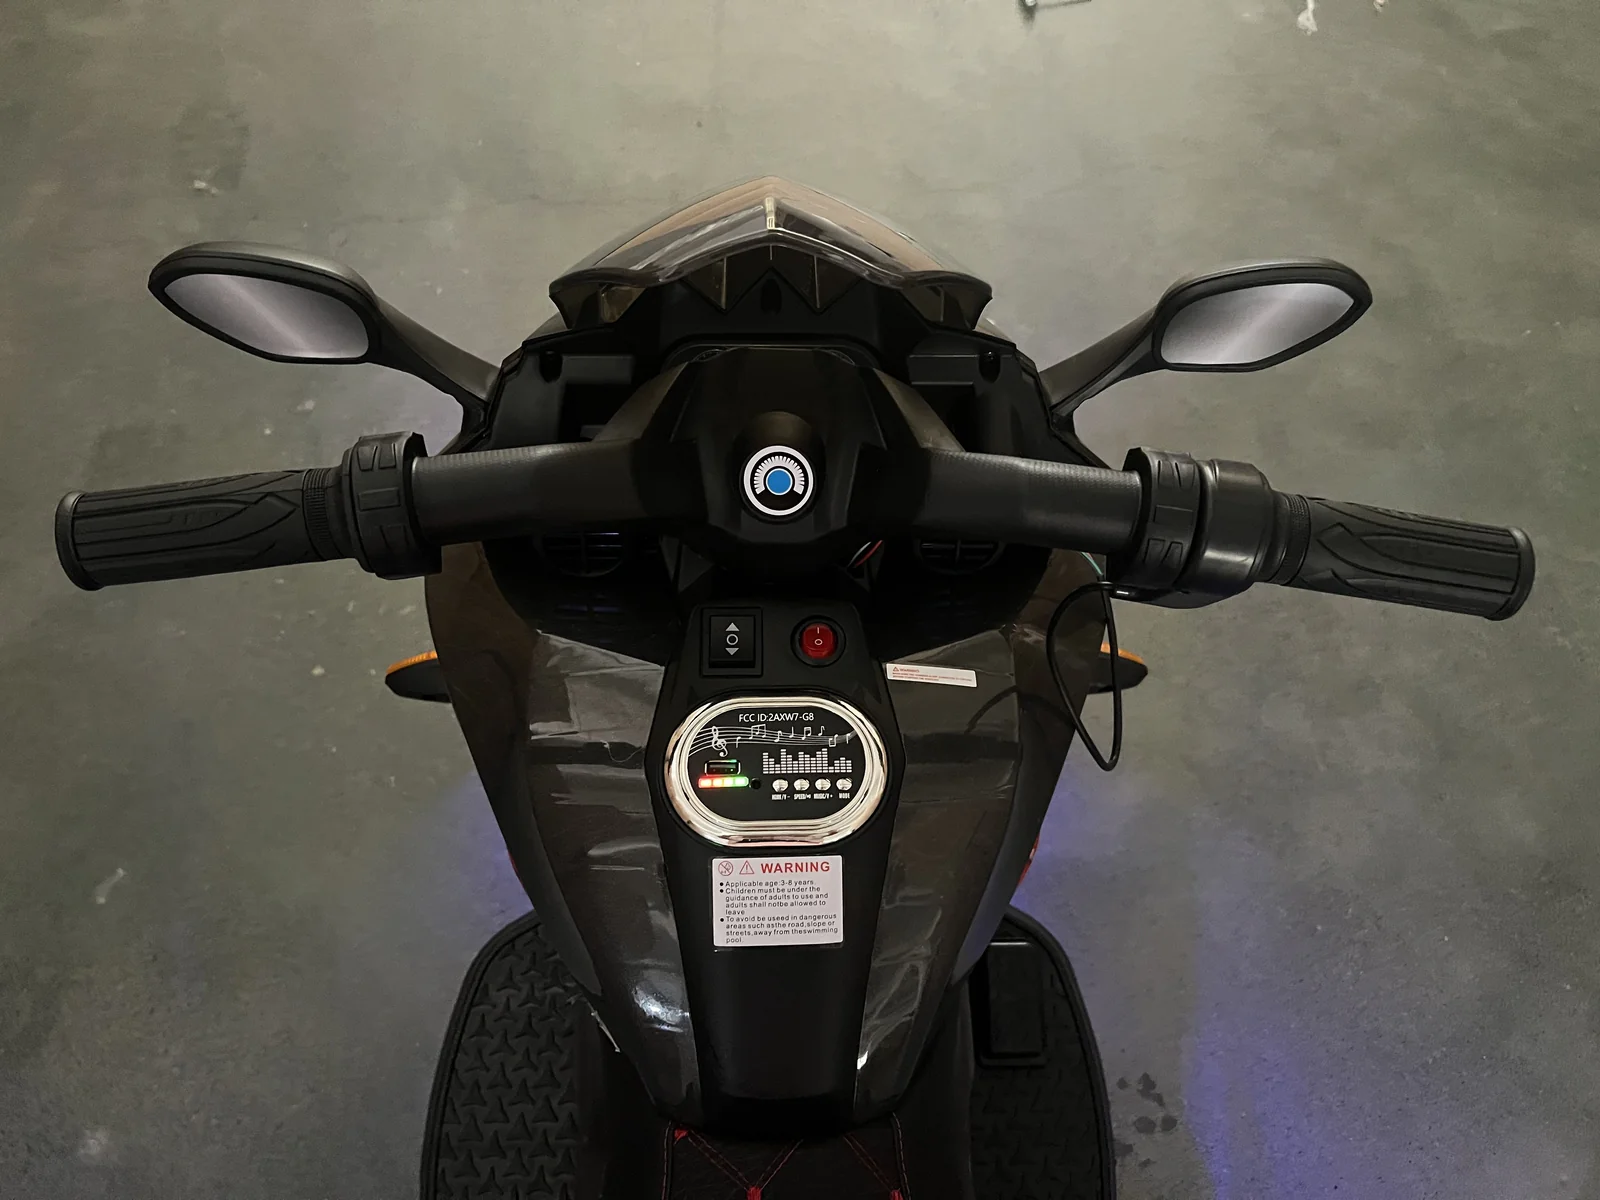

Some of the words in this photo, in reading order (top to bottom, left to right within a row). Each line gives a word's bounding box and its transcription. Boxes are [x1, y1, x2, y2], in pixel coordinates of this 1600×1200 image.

[738, 714, 756, 722] FCC
[758, 712, 814, 722] ID:2AXW7-G8
[761, 861, 830, 873] WARNING
